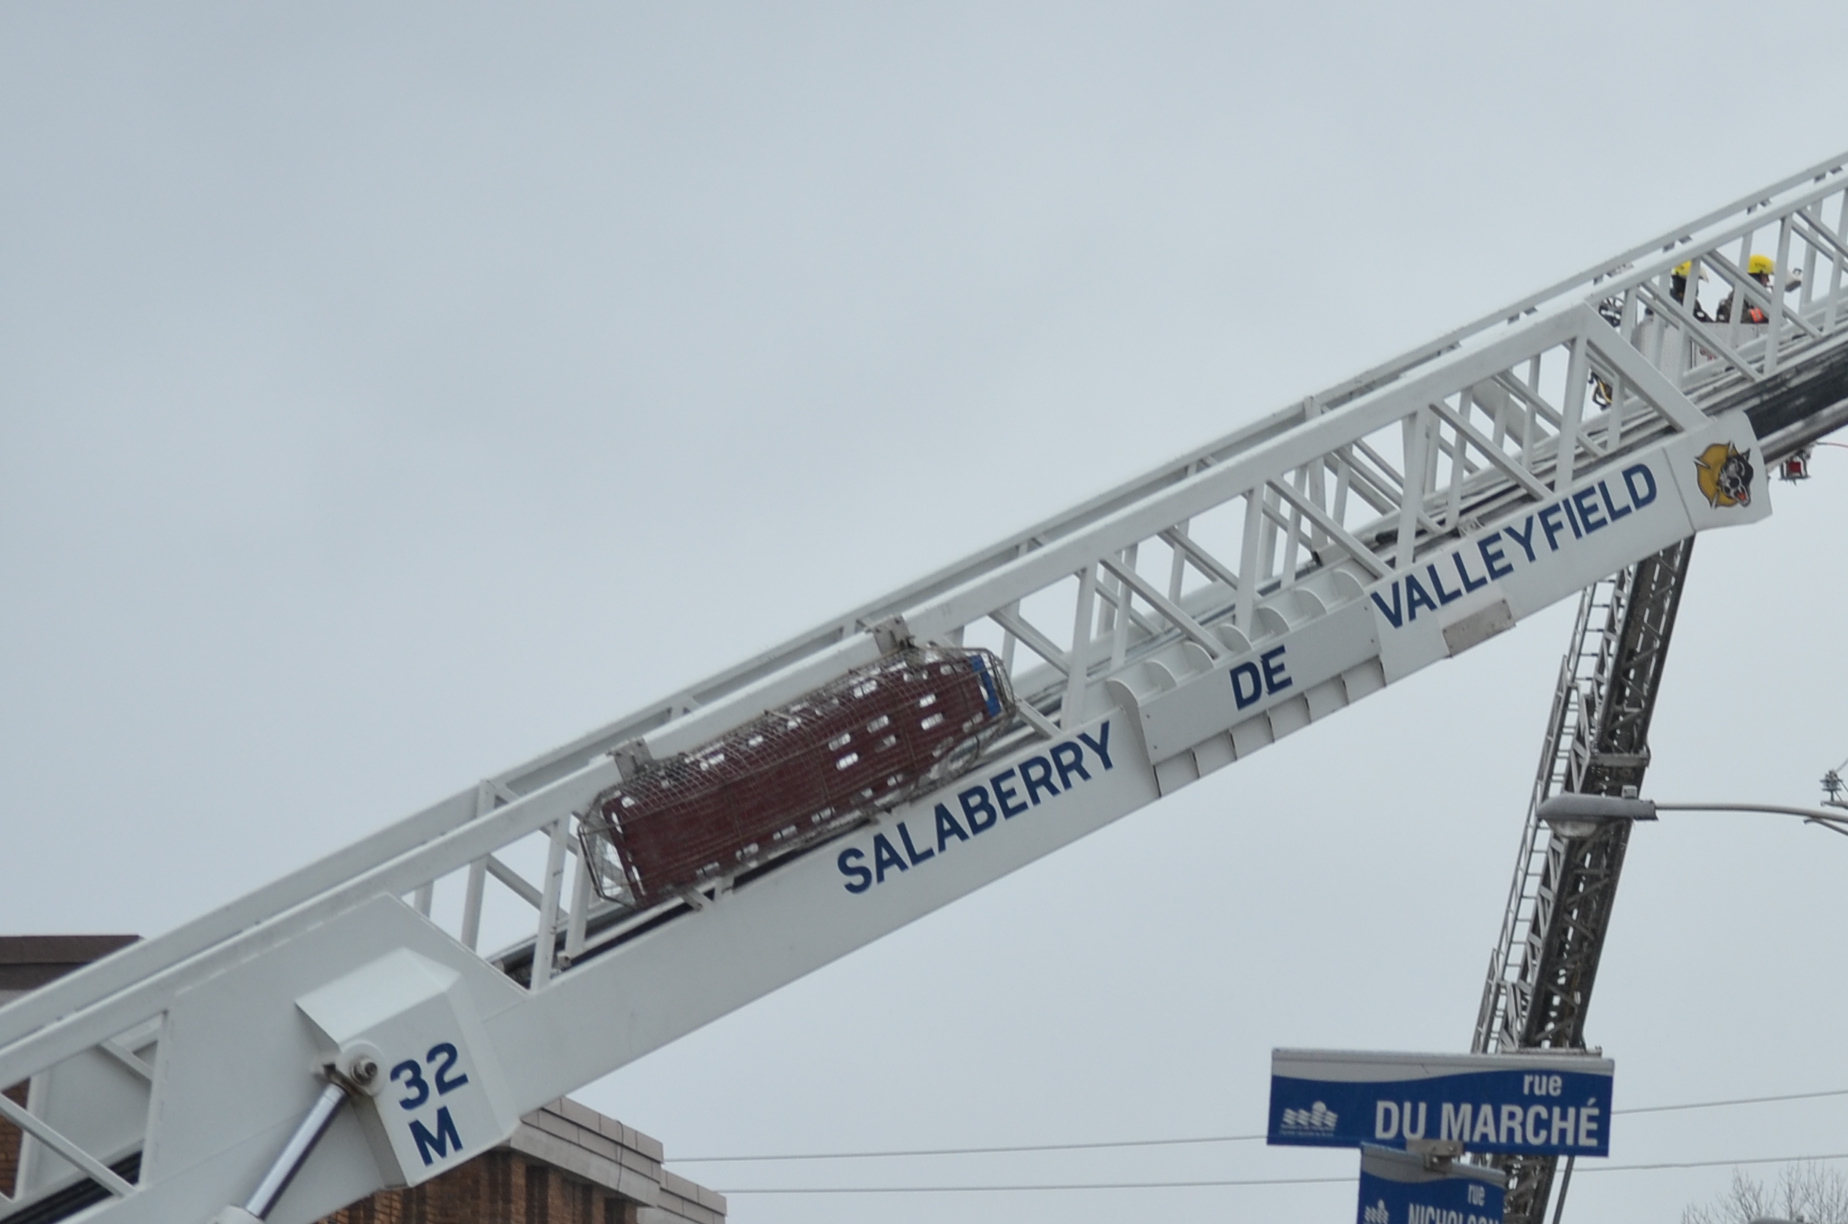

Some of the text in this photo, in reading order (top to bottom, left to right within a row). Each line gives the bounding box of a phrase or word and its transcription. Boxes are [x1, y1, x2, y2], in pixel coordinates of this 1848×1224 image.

[837, 462, 1659, 895] SALABERRY DE VALLEYFIELD
[390, 1042, 469, 1111] 32
[1523, 1074, 1562, 1096] rue
[408, 1105, 463, 1167] M
[1375, 1098, 1600, 1147] DU MARCHÉ
[1468, 1184, 1486, 1206] rue
